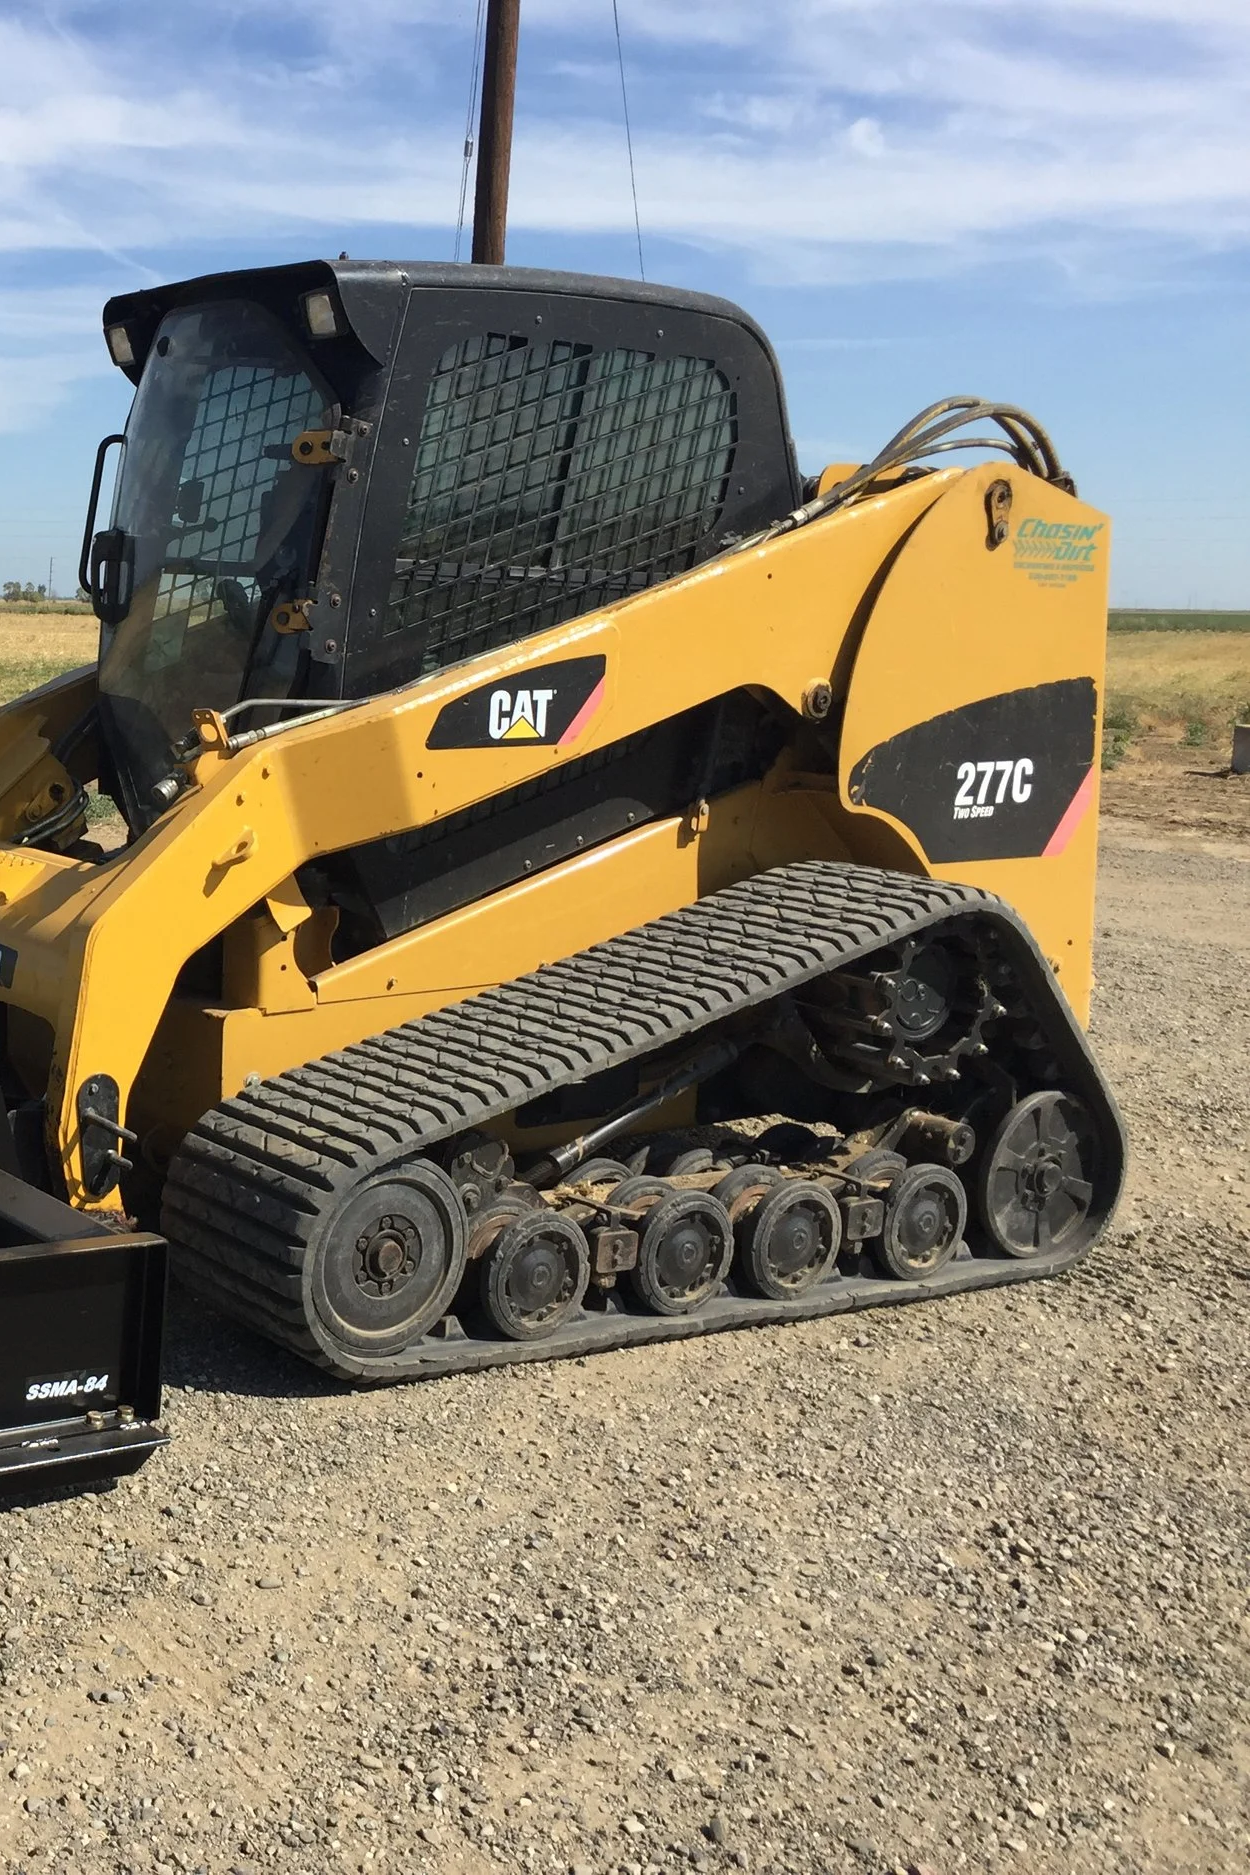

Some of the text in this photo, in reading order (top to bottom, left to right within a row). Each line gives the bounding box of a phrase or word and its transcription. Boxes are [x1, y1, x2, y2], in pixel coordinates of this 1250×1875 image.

[488, 689, 554, 740] CAT
[954, 757, 1034, 806] 277C
[25, 1374, 109, 1401] SSMA-84
